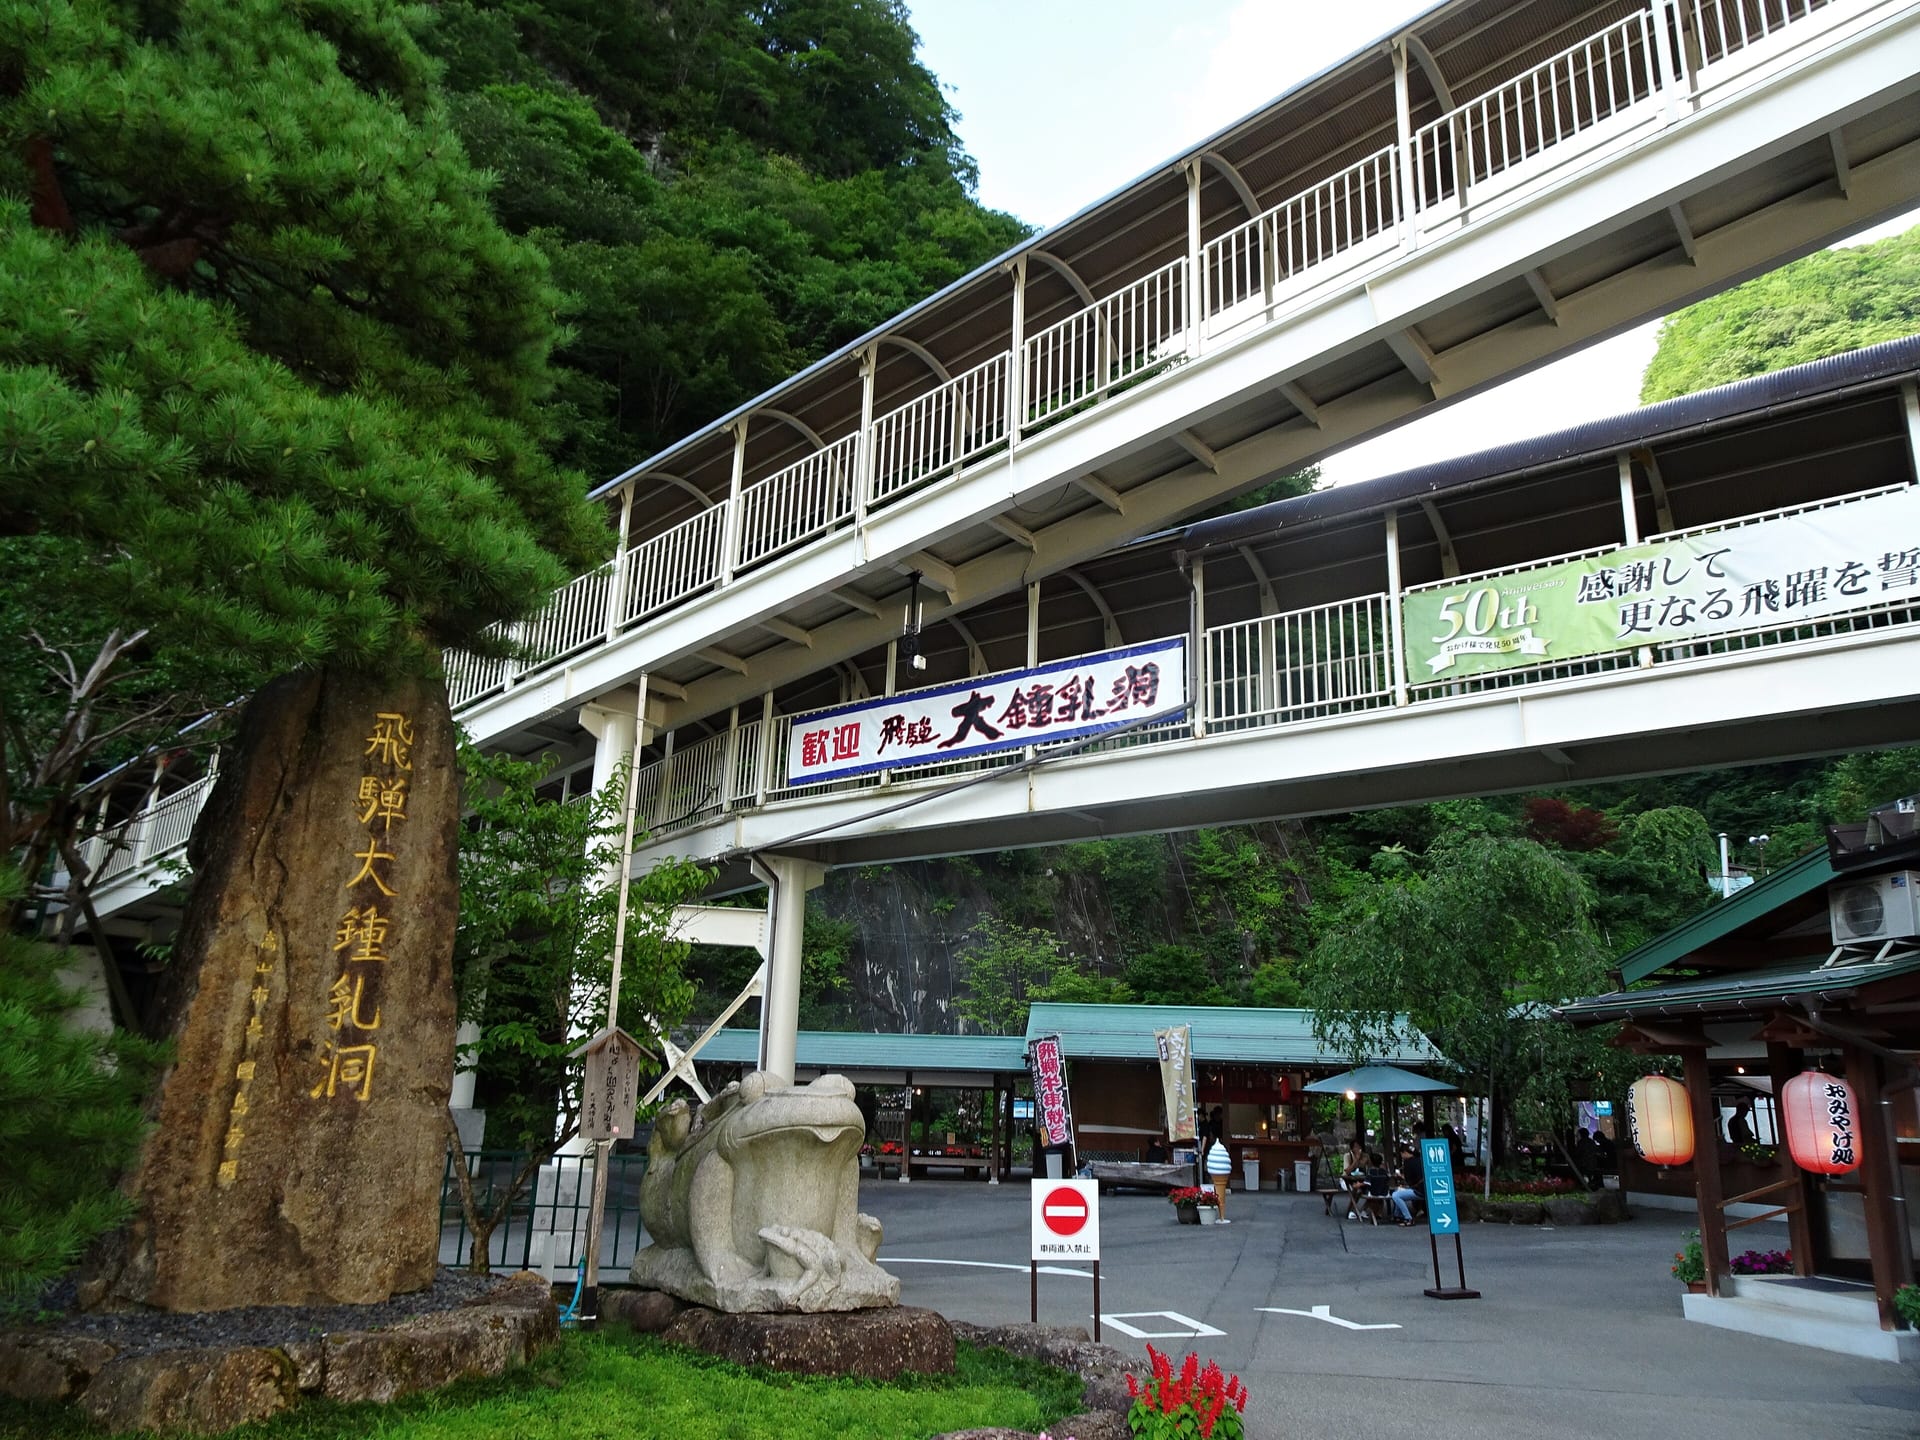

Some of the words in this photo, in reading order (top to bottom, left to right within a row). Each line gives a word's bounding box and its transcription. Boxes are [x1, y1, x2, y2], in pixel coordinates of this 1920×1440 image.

[1502, 578, 1568, 597] Anniversary
[1578, 548, 1732, 604] 感謝して
[1617, 547, 1920, 639] 更なる飛躍を誓
[1431, 587, 1539, 643] 50th
[802, 721, 860, 768] 歓迎
[1824, 1083, 1855, 1165] おみやげ処
[1040, 1243, 1092, 1254] 車両進入禁止
